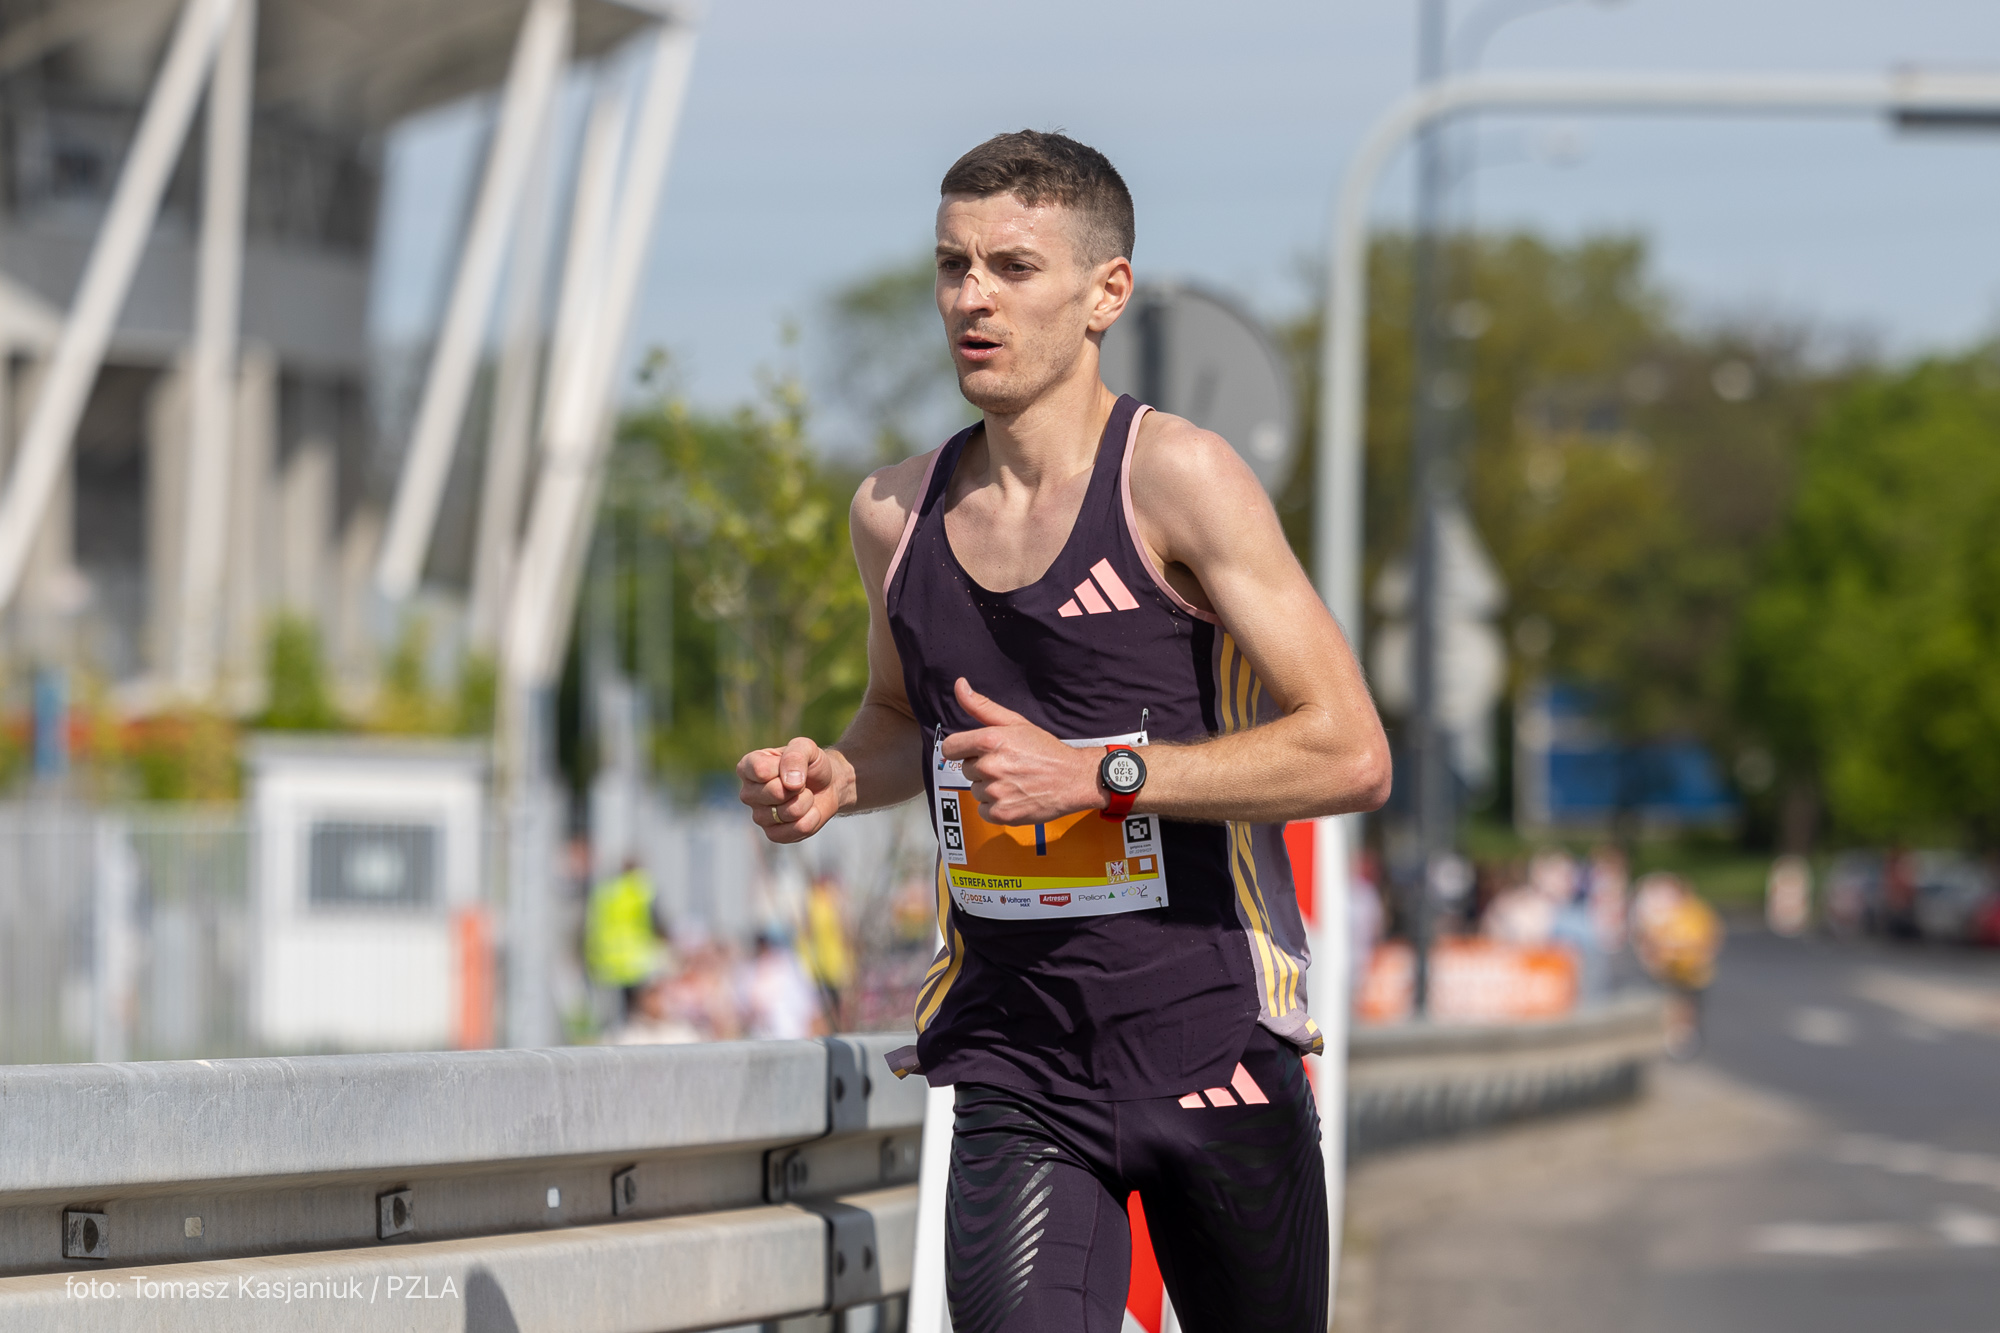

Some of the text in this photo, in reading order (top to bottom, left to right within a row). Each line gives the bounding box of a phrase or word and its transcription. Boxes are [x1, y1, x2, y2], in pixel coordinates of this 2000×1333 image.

[952, 876, 1022, 888] 1. STREFA STARTU
